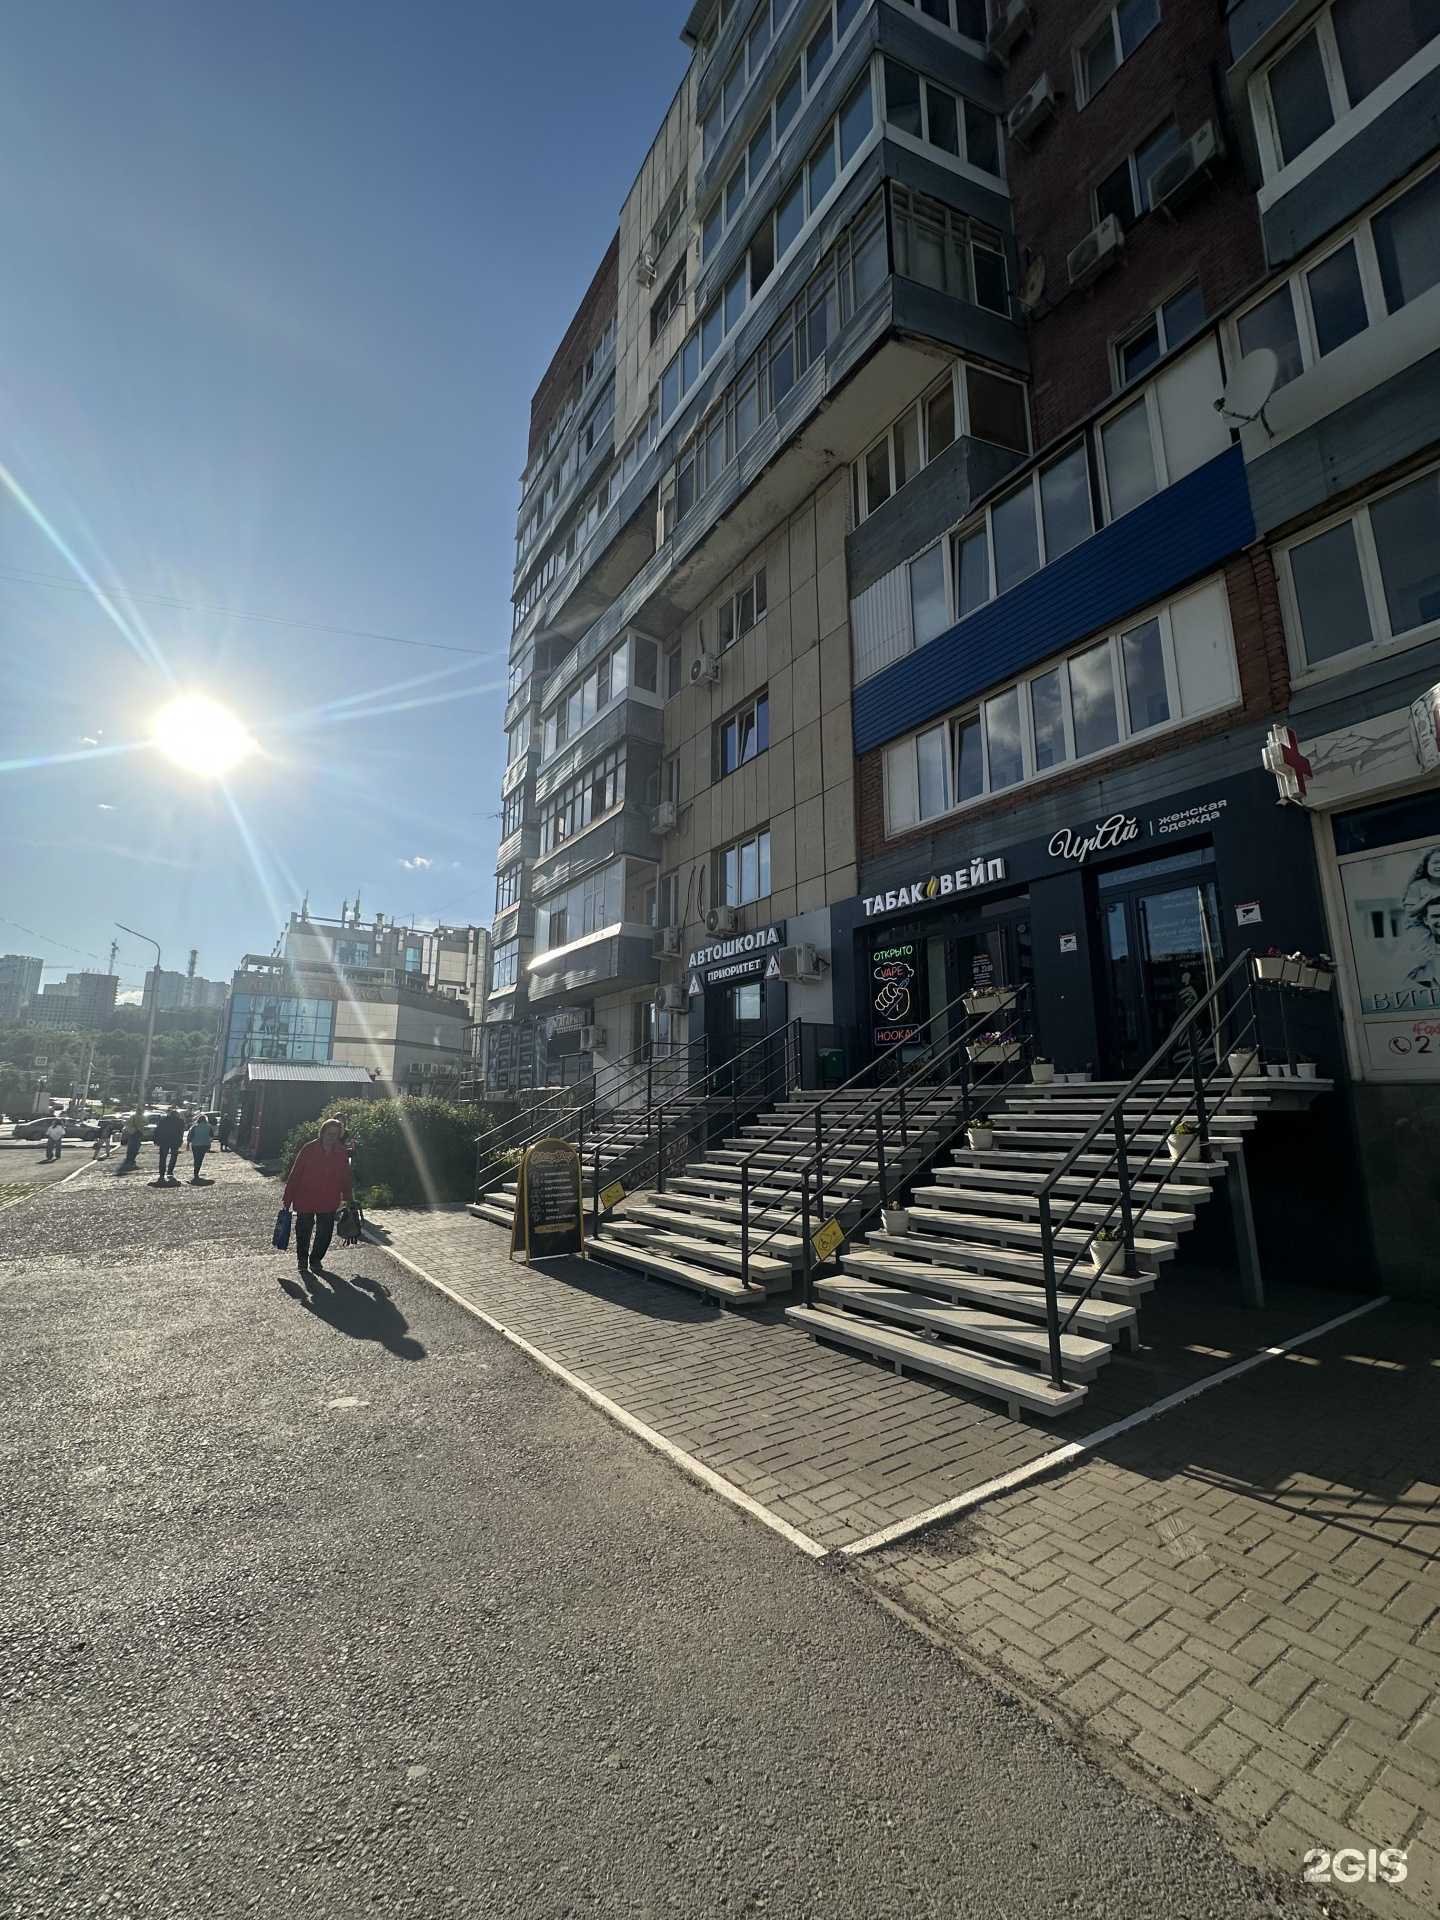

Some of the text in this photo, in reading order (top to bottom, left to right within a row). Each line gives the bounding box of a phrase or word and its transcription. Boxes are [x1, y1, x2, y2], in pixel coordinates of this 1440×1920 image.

[1158, 799, 1228, 825] женская
[1158, 811, 1221, 834] одежда
[1047, 814, 1139, 863] ИрАй
[862, 857, 1006, 916] ТАБАК ВЕЙП
[688, 927, 780, 968] АВТОШКОЛА
[873, 945, 913, 961] ОТКРЫТО
[707, 959, 761, 982] ПРИОРИТЕТ
[880, 965, 904, 977] VAPE
